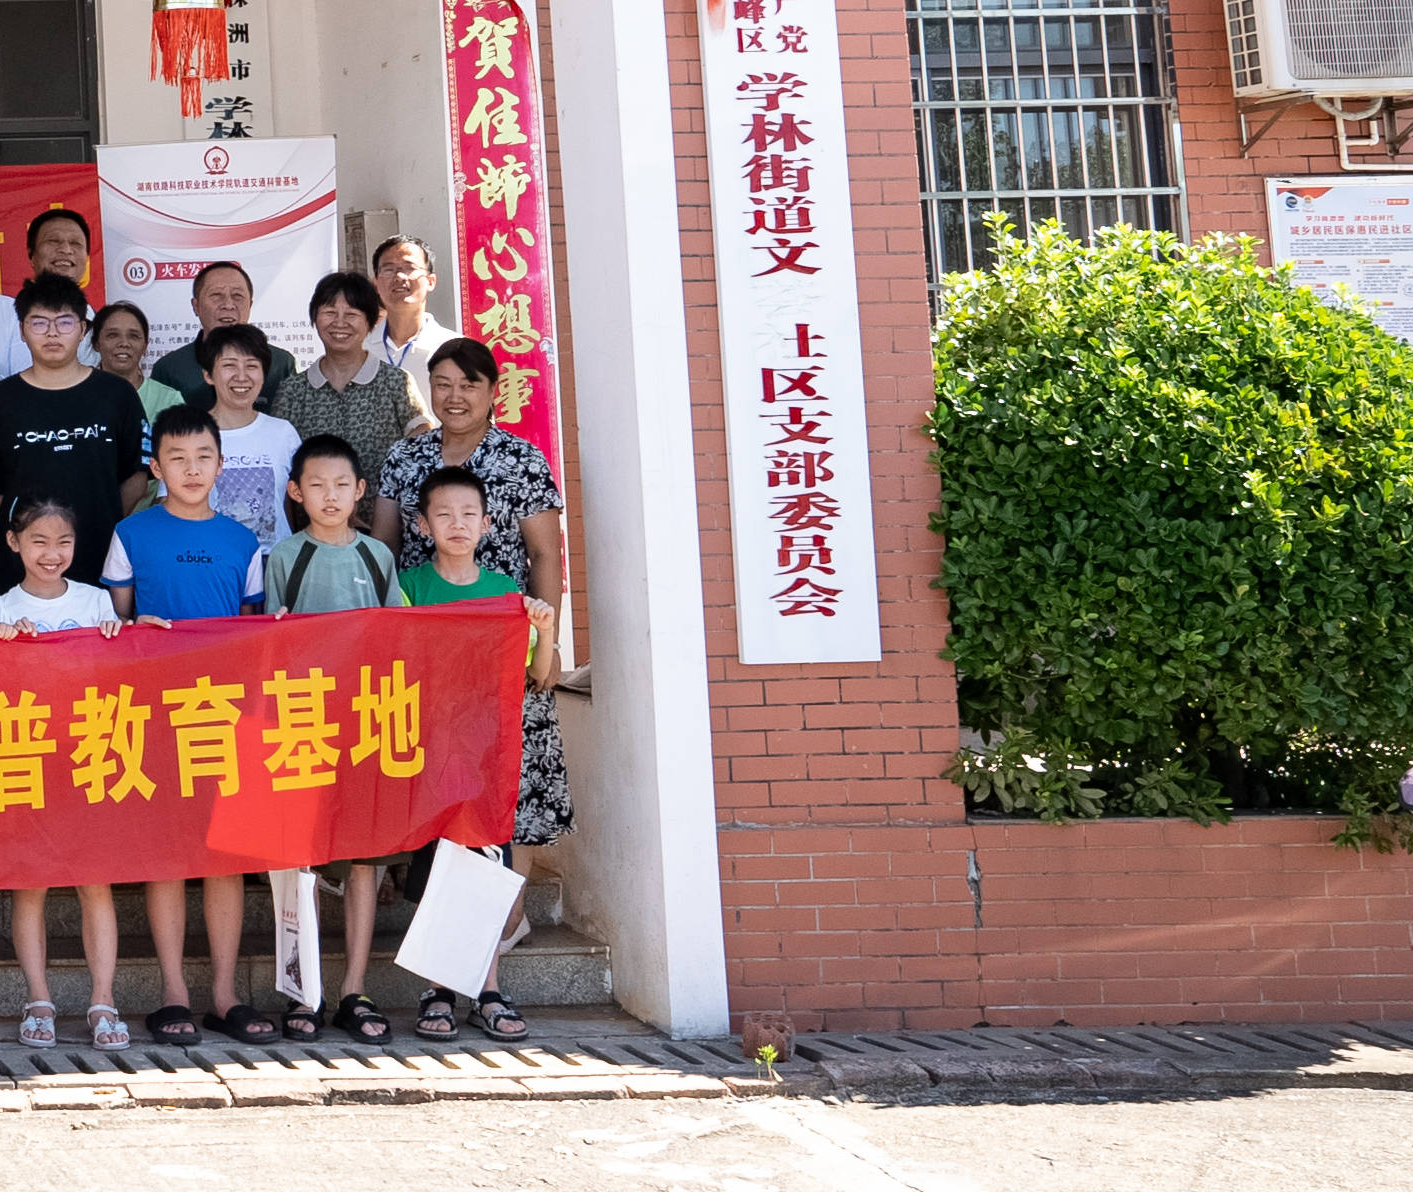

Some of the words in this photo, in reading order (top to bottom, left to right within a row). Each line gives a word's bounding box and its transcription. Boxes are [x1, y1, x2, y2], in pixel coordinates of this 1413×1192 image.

[129, 267, 145, 279] 03
[161, 262, 211, 278] 火车发
